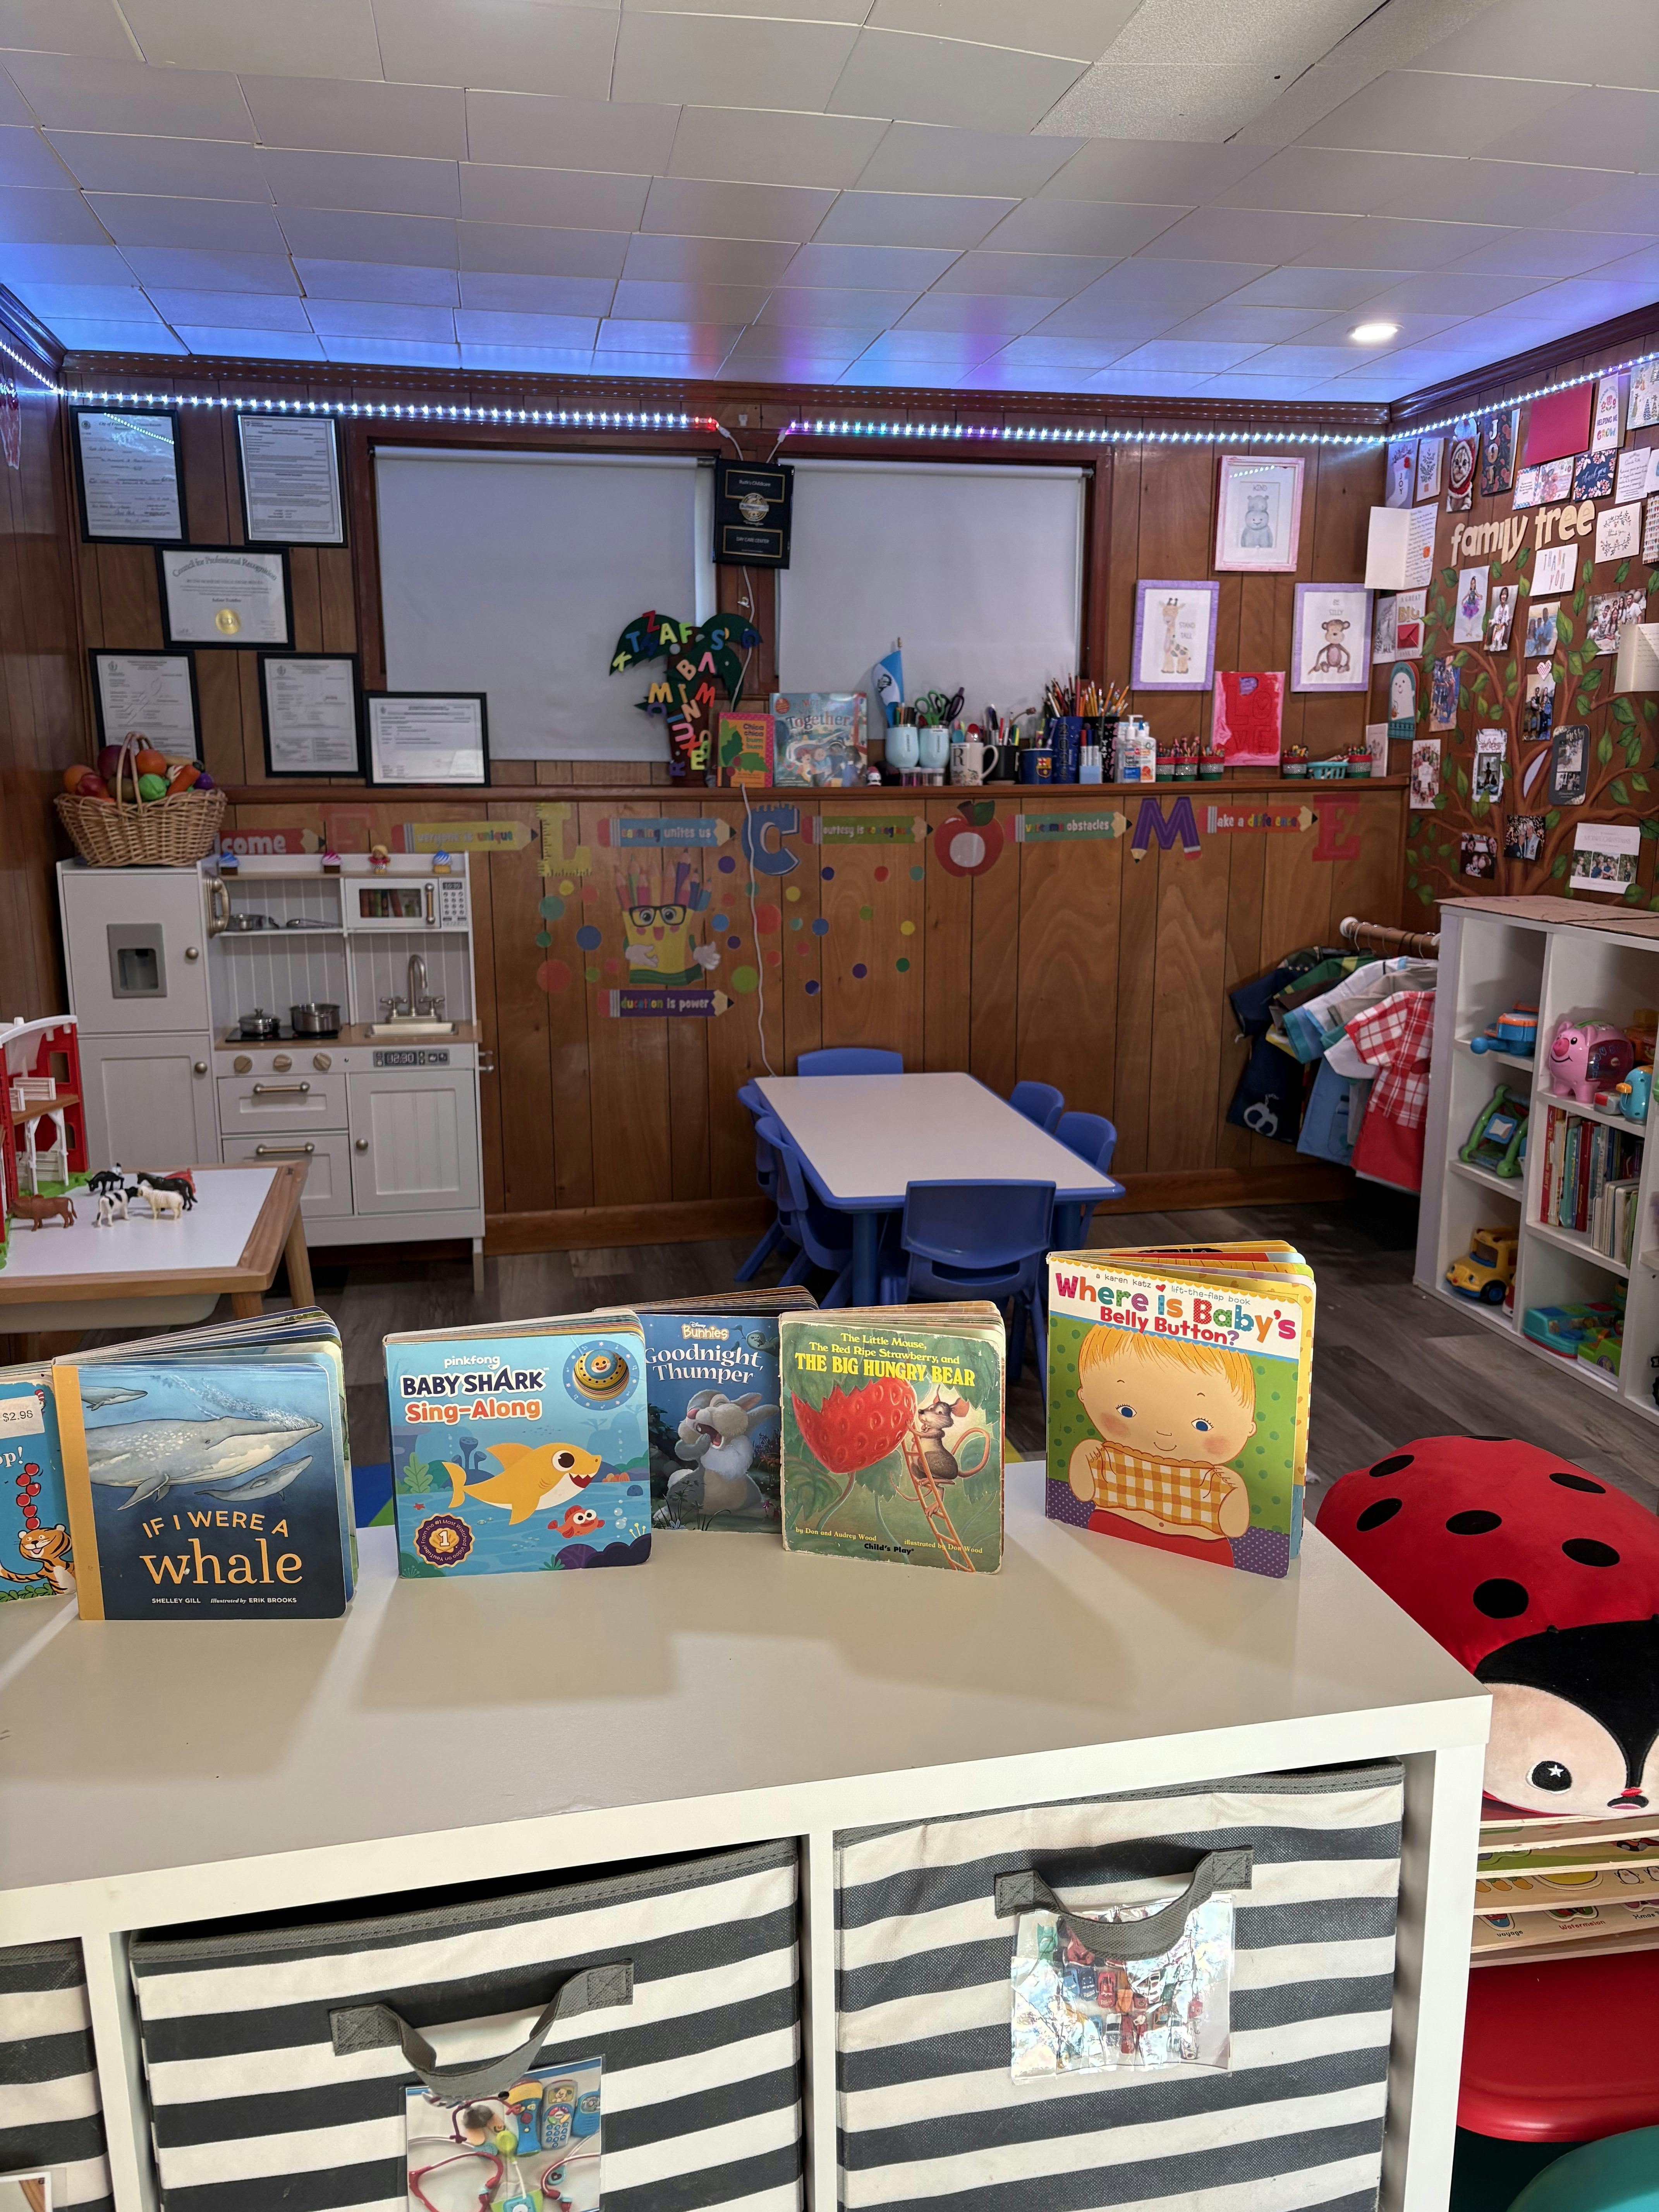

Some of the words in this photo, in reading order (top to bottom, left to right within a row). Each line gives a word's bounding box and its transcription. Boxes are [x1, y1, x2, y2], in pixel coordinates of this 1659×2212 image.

[1597, 416, 1612, 426] HELPING
[1534, 500, 1595, 551] tree
[242, 558, 277, 581] Recognition
[1543, 550, 1565, 571] THANK
[1549, 570, 1565, 590] YOU
[785, 710, 851, 730] Together
[953, 748, 965, 766] R
[1066, 819, 1109, 831] obstacles
[1131, 797, 1202, 863] M
[1217, 813, 1234, 828] ake
[1238, 817, 1244, 827] a
[1312, 791, 1361, 862] E
[663, 827, 695, 838] unites
[699, 828, 711, 838] us
[741, 802, 801, 876] C
[621, 996, 663, 1010] ducation
[666, 997, 676, 1009] is
[679, 999, 709, 1012] power
[1104, 1273, 1128, 1285] karen
[1132, 1277, 1152, 1288] katz
[1171, 1285, 1224, 1302] lift-the-flap
[1228, 1295, 1251, 1305] book
[1055, 1273, 1149, 1312] Where
[1157, 1289, 1184, 1318] is
[1193, 1298, 1297, 1343] Baby's
[681, 1324, 730, 1341] Bunnies
[1100, 1306, 1149, 1334] Belly
[1154, 1317, 1240, 1346] Button?
[840, 1332, 860, 1343] The
[862, 1334, 889, 1346] Little
[891, 1338, 927, 1350] Mouse,
[444, 1355, 501, 1370] pinkfong
[644, 1343, 764, 1371] Goodnight,
[809, 1341, 828, 1352] The
[831, 1344, 851, 1354] Red
[853, 1346, 877, 1357] Ripe
[879, 1348, 938, 1364] Strawberry,
[940, 1355, 960, 1365] and
[652, 1363, 754, 1384] Thumper
[795, 1352, 827, 1372] THE
[832, 1356, 859, 1375] BIG
[863, 1359, 927, 1382] HUNGRY
[931, 1365, 976, 1387] BEAR
[402, 1374, 461, 1396] BABY
[464, 1367, 544, 1393] SHARK
[407, 1398, 541, 1424] Sing-Along
[0, 1446, 23, 1468] p!
[142, 1517, 164, 1538] IF
[173, 1514, 181, 1530] I
[187, 1510, 265, 1531] WERE
[271, 1519, 289, 1537] A
[795, 1527, 804, 1535] by
[834, 1530, 856, 1540] Audrey
[858, 1533, 877, 1542] Wood
[438, 1530, 450, 1547] 1
[864, 1543, 891, 1552] Child's
[904, 1538, 936, 1549] illustrated
[937, 1543, 946, 1551] by
[947, 1544, 962, 1552] Don
[963, 1546, 983, 1554] Wood
[139, 1538, 303, 1584] whale
[1559, 1920, 1606, 1931] Watermelon
